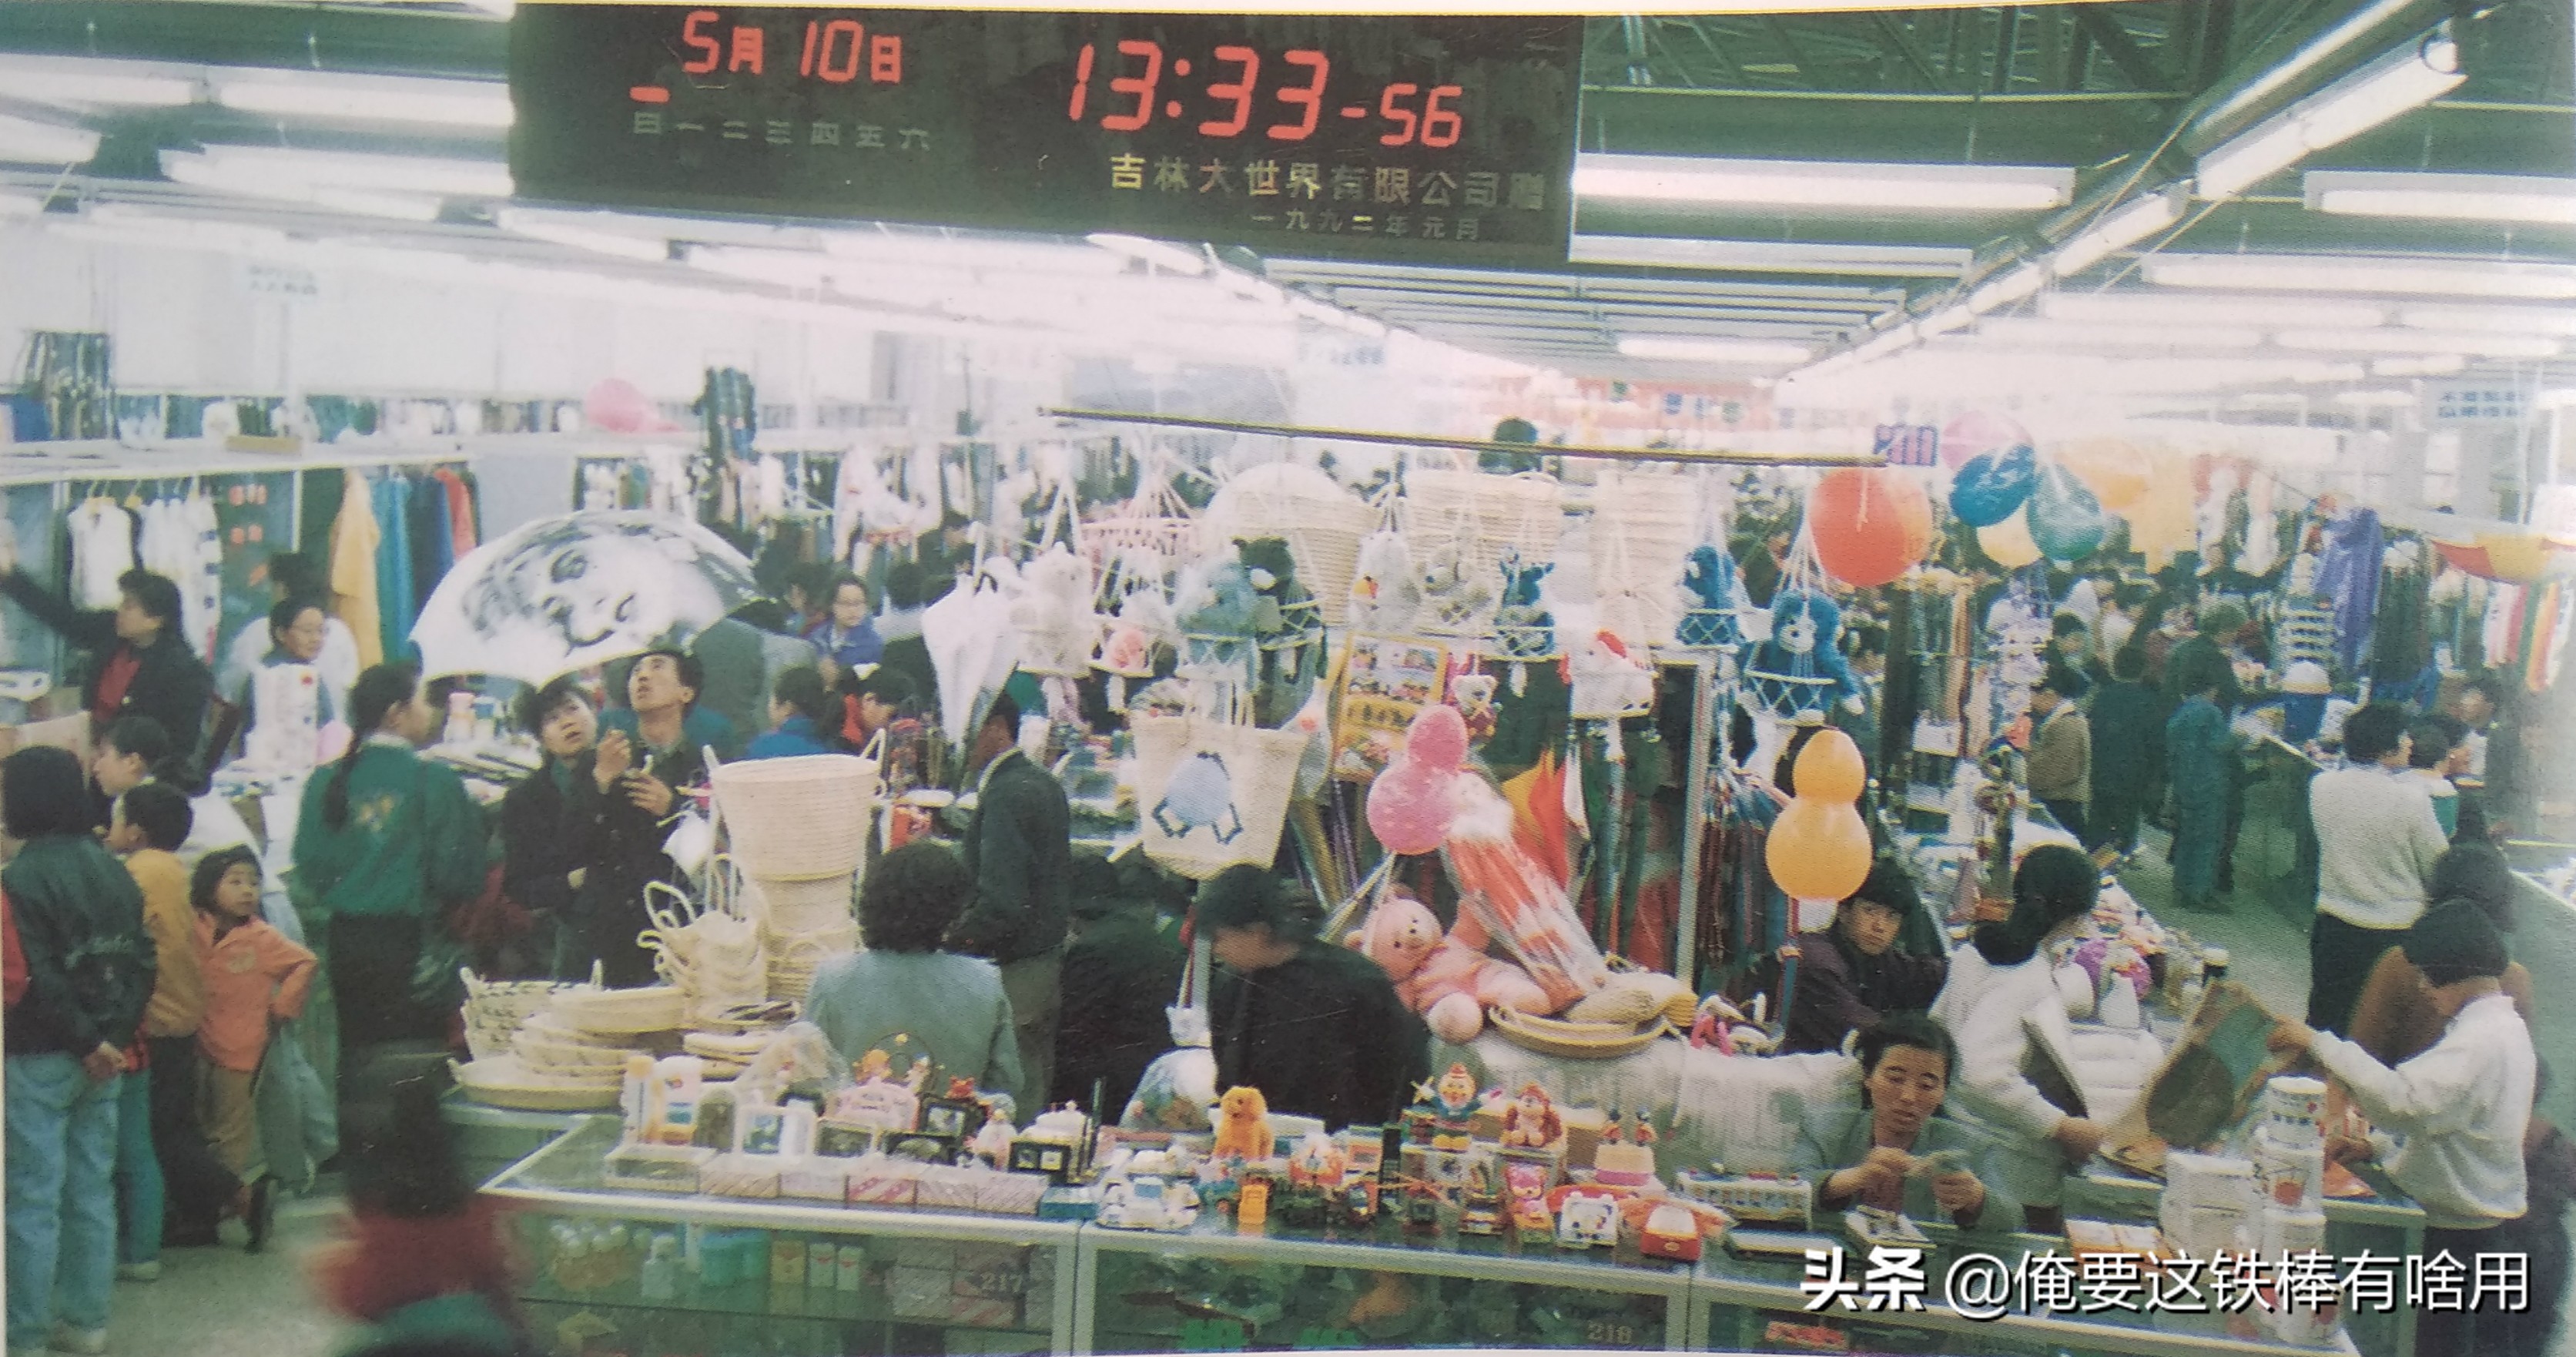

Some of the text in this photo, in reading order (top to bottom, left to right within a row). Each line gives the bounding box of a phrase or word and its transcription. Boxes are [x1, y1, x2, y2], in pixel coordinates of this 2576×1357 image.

[684, 12, 901, 82] 5月 10日
[1069, 40, 1463, 148] 13:33-56
